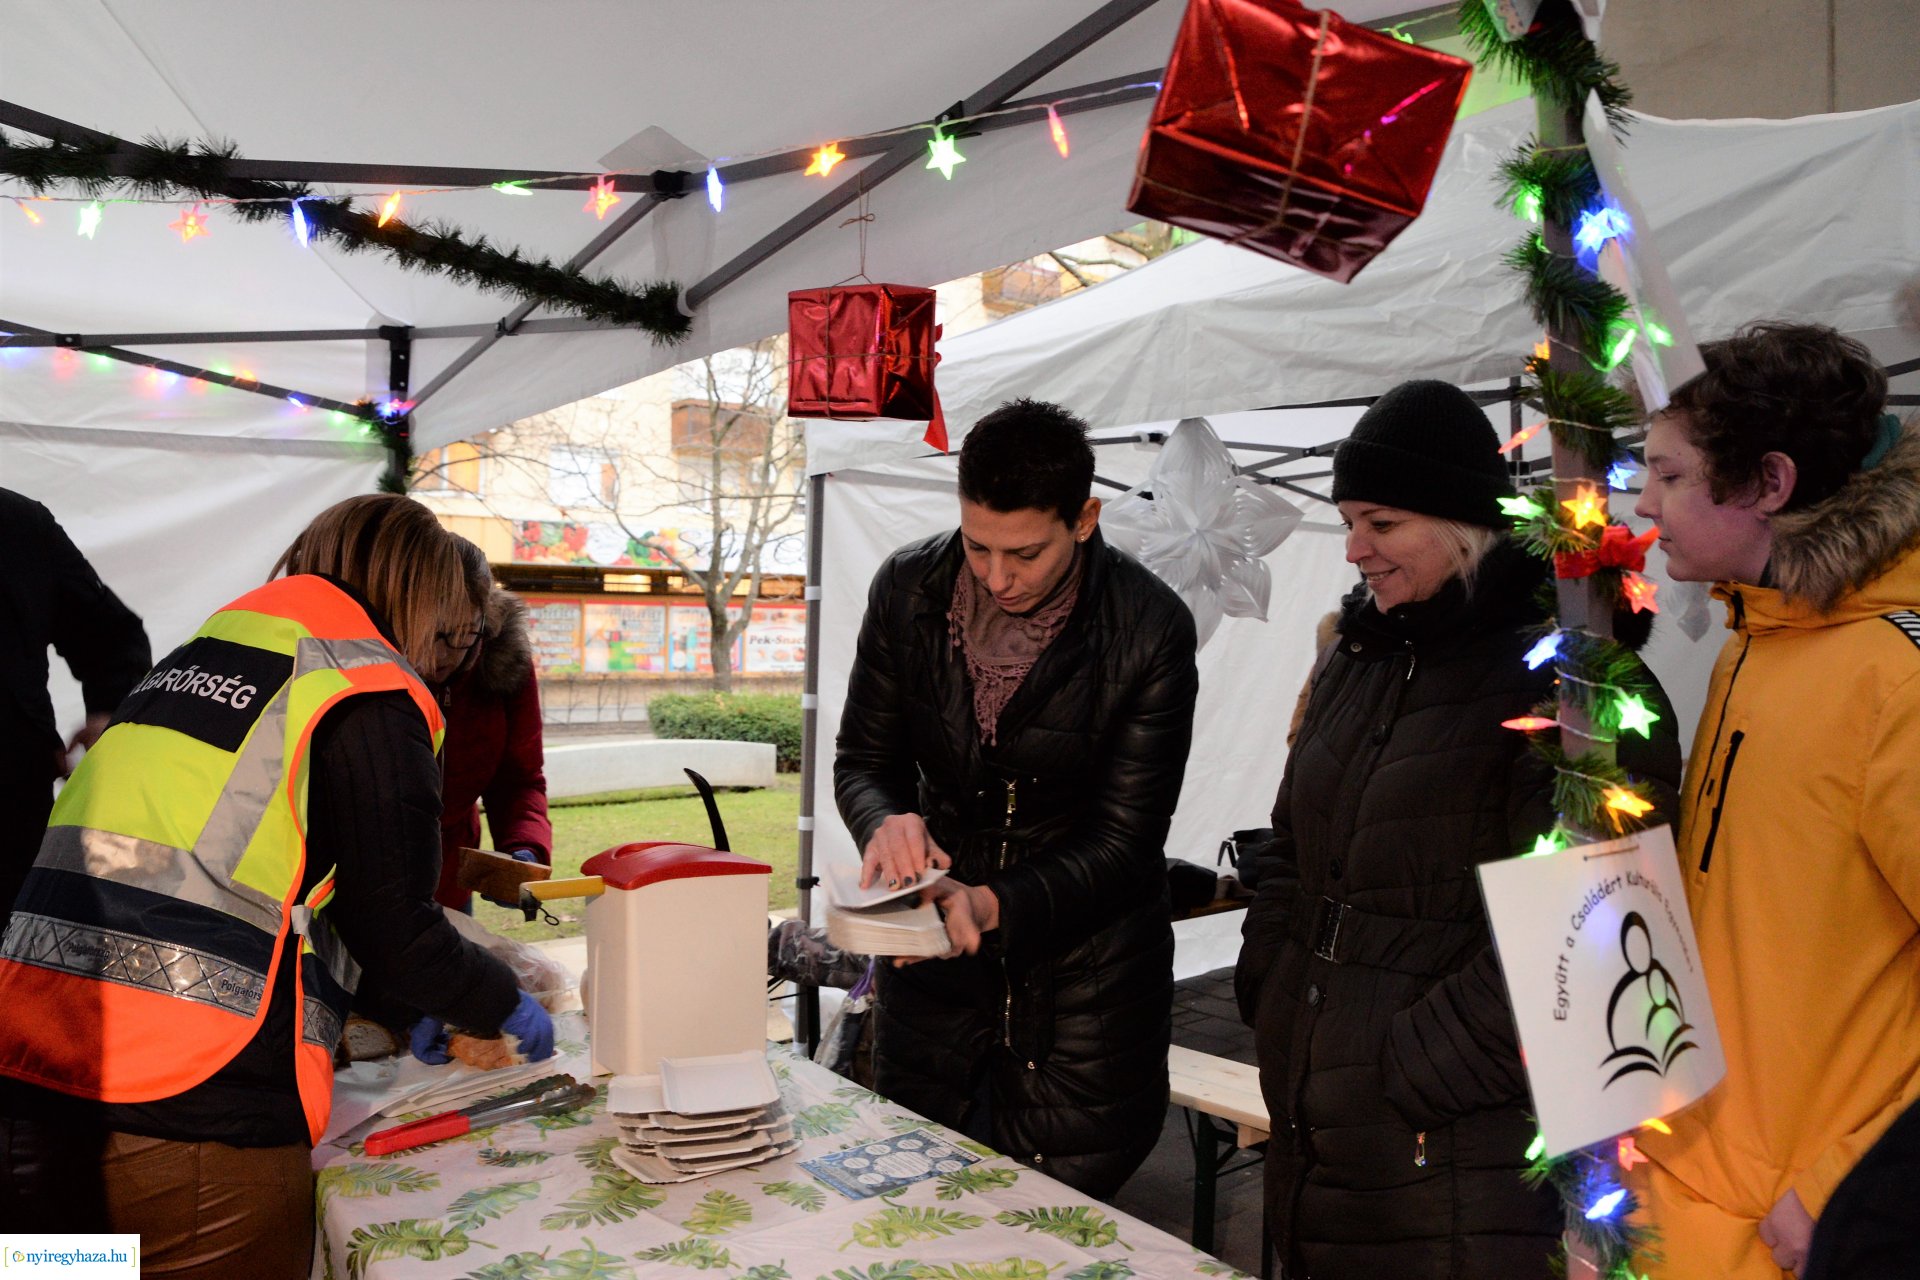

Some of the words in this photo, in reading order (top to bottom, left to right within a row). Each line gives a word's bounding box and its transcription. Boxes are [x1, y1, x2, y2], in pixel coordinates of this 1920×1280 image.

[749, 634, 806, 646] Pek-Snac
[1553, 953, 1570, 1021] Együtt
[1566, 935, 1575, 948] a
[1571, 874, 1622, 931] Családért
